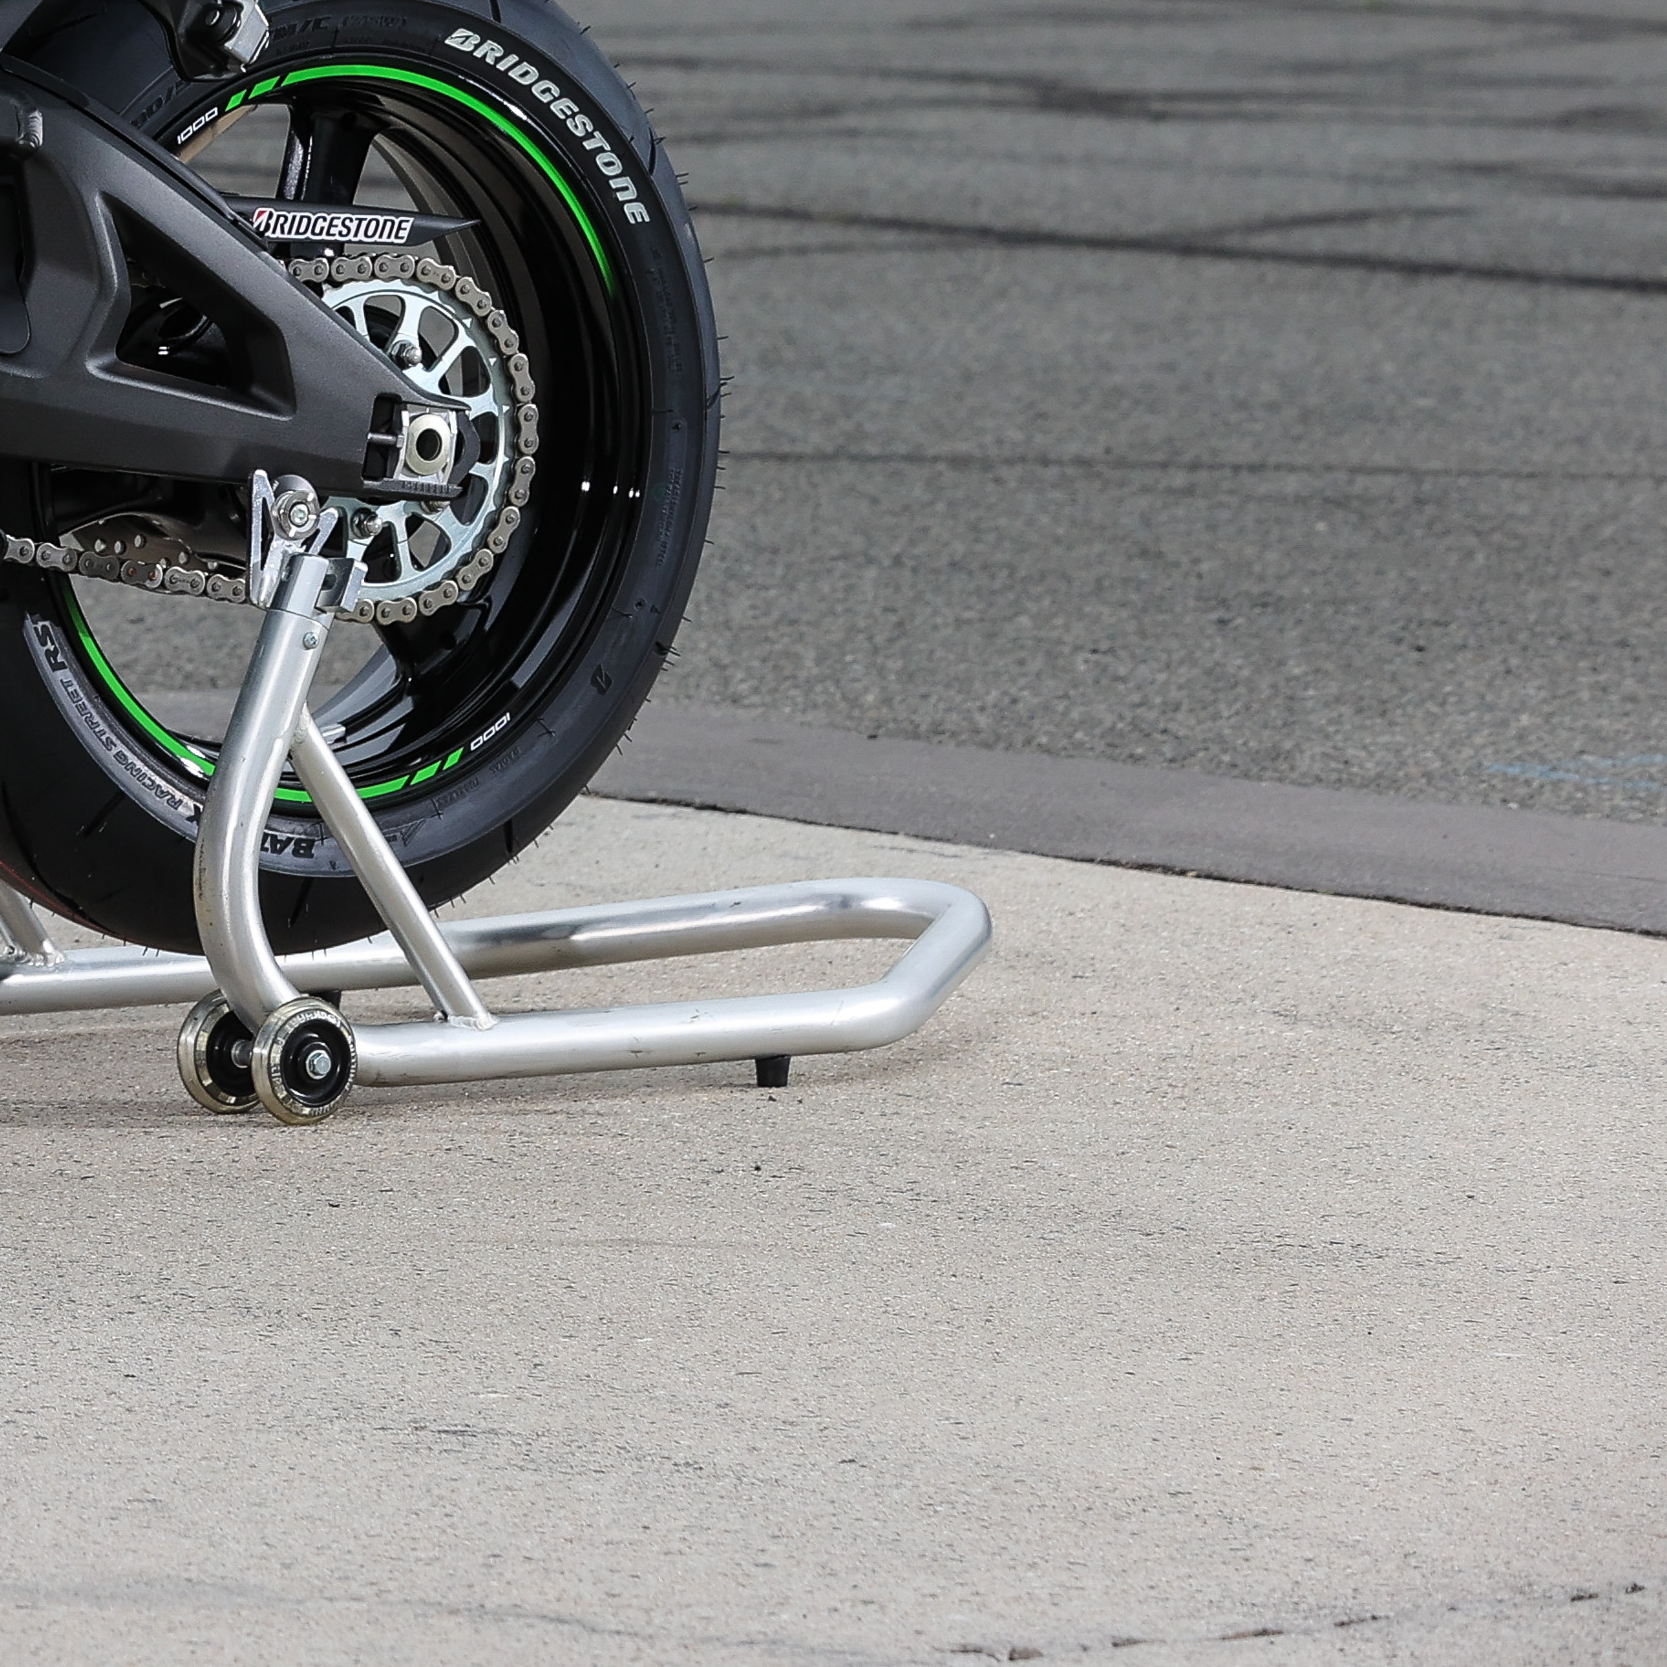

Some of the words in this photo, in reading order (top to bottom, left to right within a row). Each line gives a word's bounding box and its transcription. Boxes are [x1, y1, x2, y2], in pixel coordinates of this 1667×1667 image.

[177, 107, 219, 145] 1000
[444, 28, 651, 224] BRIDGESTONE
[253, 210, 412, 242] BRIDGESTONE
[60, 678, 118, 753] STREET
[470, 712, 511, 752] 1000
[114, 748, 183, 811] RACING
